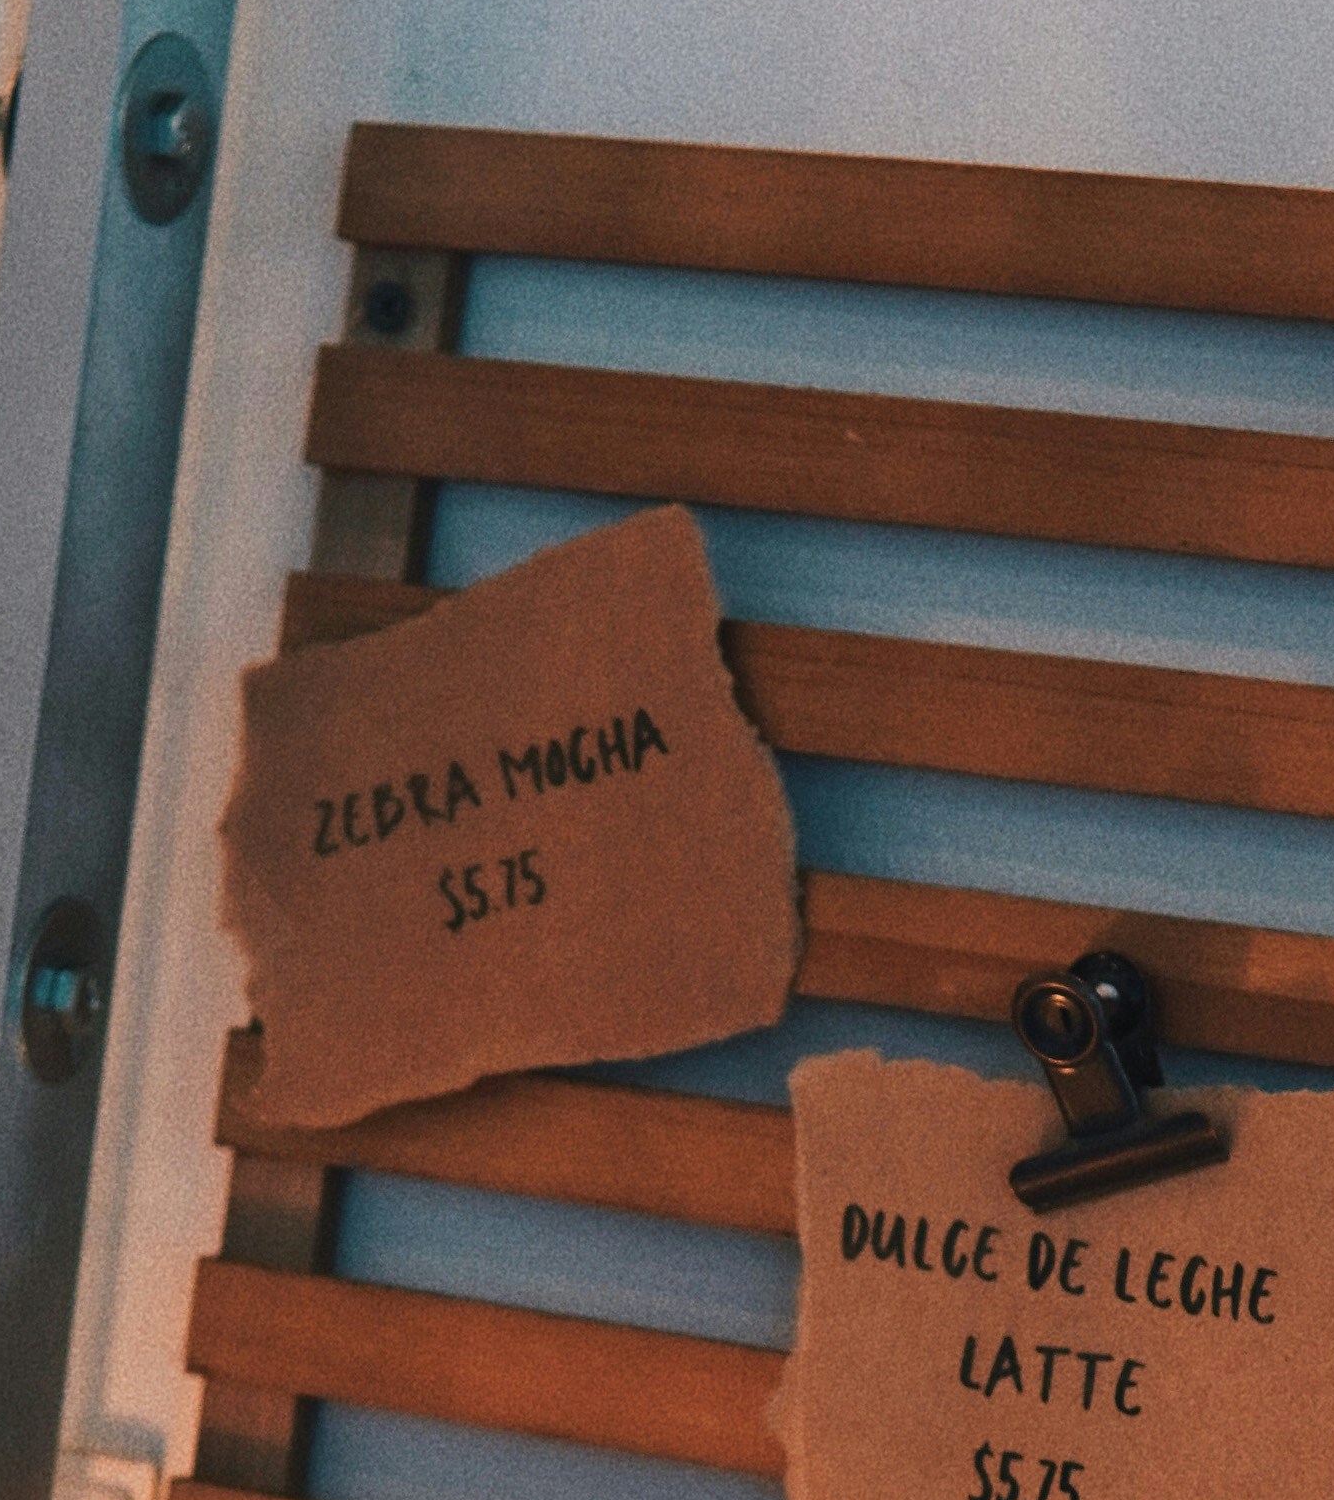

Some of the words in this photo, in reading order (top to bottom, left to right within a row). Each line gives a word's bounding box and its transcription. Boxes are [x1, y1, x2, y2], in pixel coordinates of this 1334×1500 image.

[314, 761, 481, 857] ZEBRA
[499, 710, 667, 797] MOCHA
[438, 851, 546, 933] $5.75
[841, 1204, 999, 1282] DULCE
[1028, 1232, 1087, 1295] DE
[1114, 1248, 1276, 1324] LECHE
[959, 1334, 1142, 1417] LATTE
